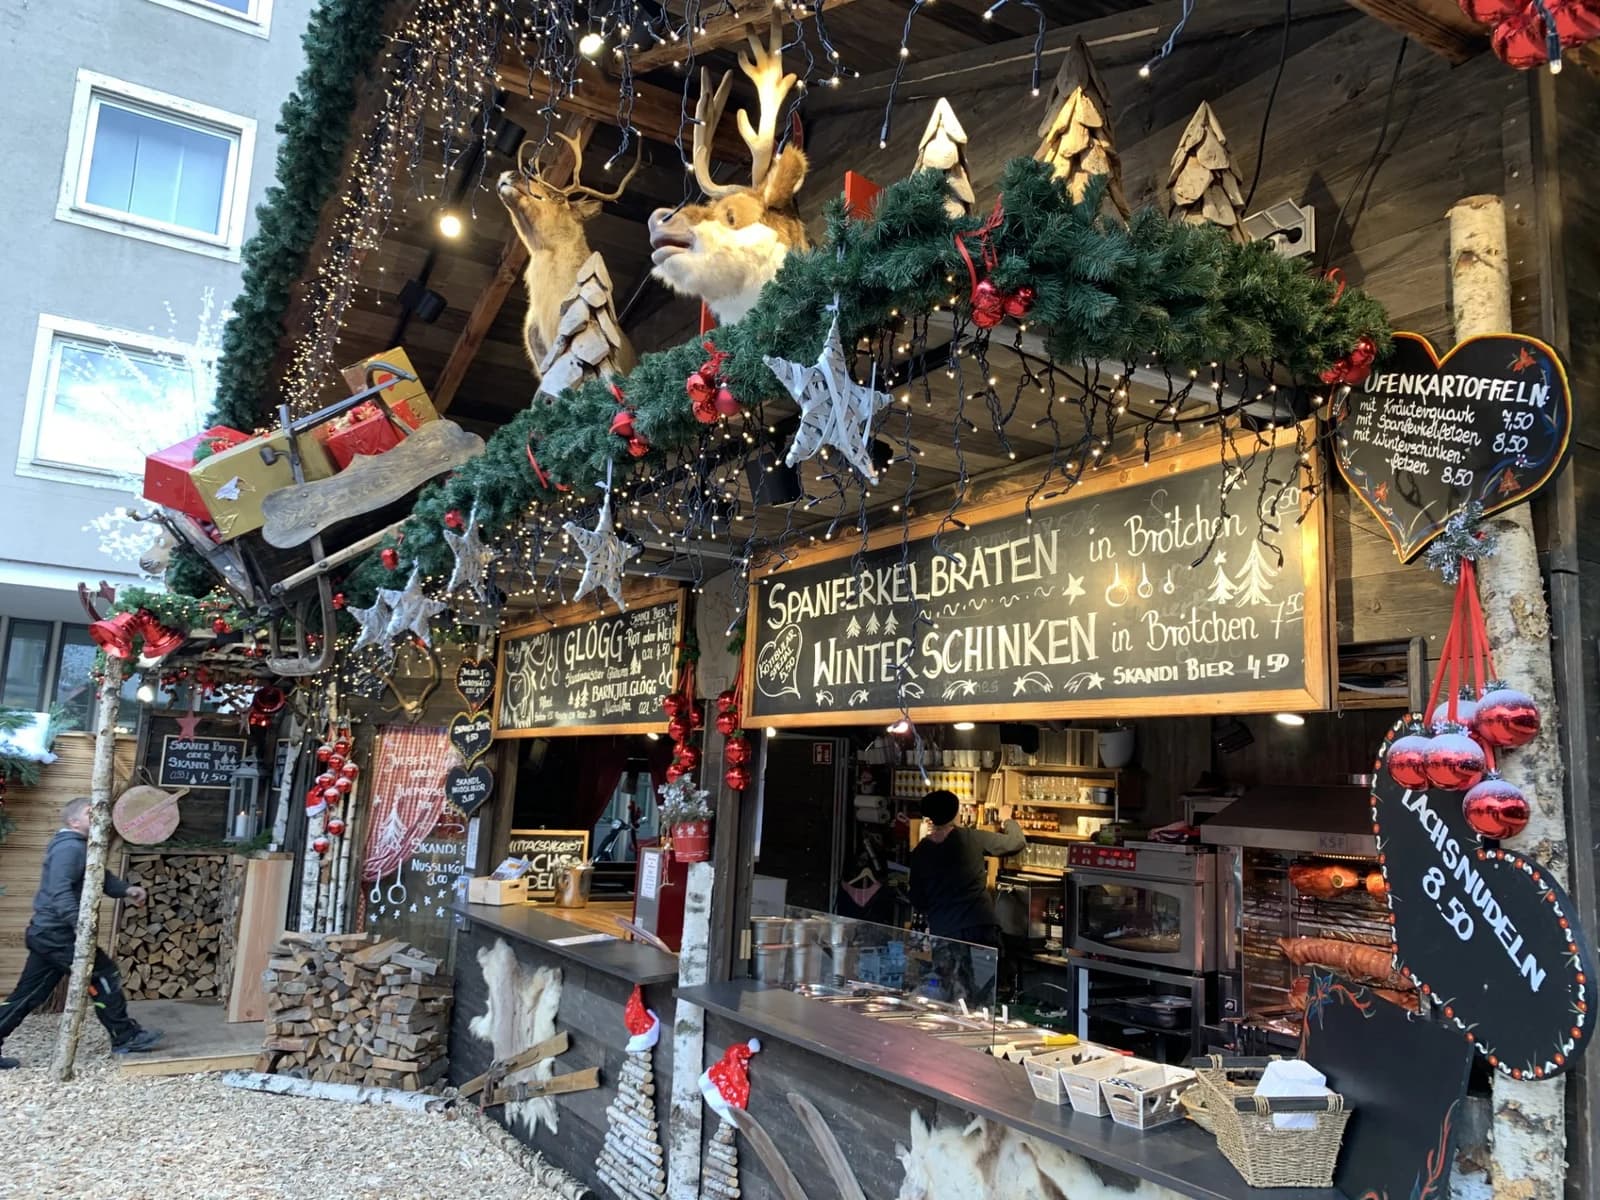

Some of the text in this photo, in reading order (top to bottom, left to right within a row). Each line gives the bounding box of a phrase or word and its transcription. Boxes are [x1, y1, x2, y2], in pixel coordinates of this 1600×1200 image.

[1360, 397, 1535, 431] mit Kräuterquark 7,50
[1353, 427, 1371, 442] mit
[1356, 412, 1373, 426] mit
[1492, 432, 1528, 455] 8,50
[1441, 466, 1474, 487] 8,50
[767, 529, 1061, 630] SPANFERKELBRATEN
[1089, 527, 1116, 562] in
[1124, 503, 1247, 557] Brötchen
[564, 619, 625, 671] GLÖGG
[922, 611, 1100, 680] SCHINKEN
[1111, 622, 1134, 653] in
[1140, 606, 1259, 651] Brötchen
[1113, 664, 1179, 685] SKANDI
[1184, 657, 1235, 681] BIER
[168, 740, 210, 751] SKANDI
[167, 757, 210, 770] SKANDI
[1401, 788, 1546, 992] LACHSNUDELN
